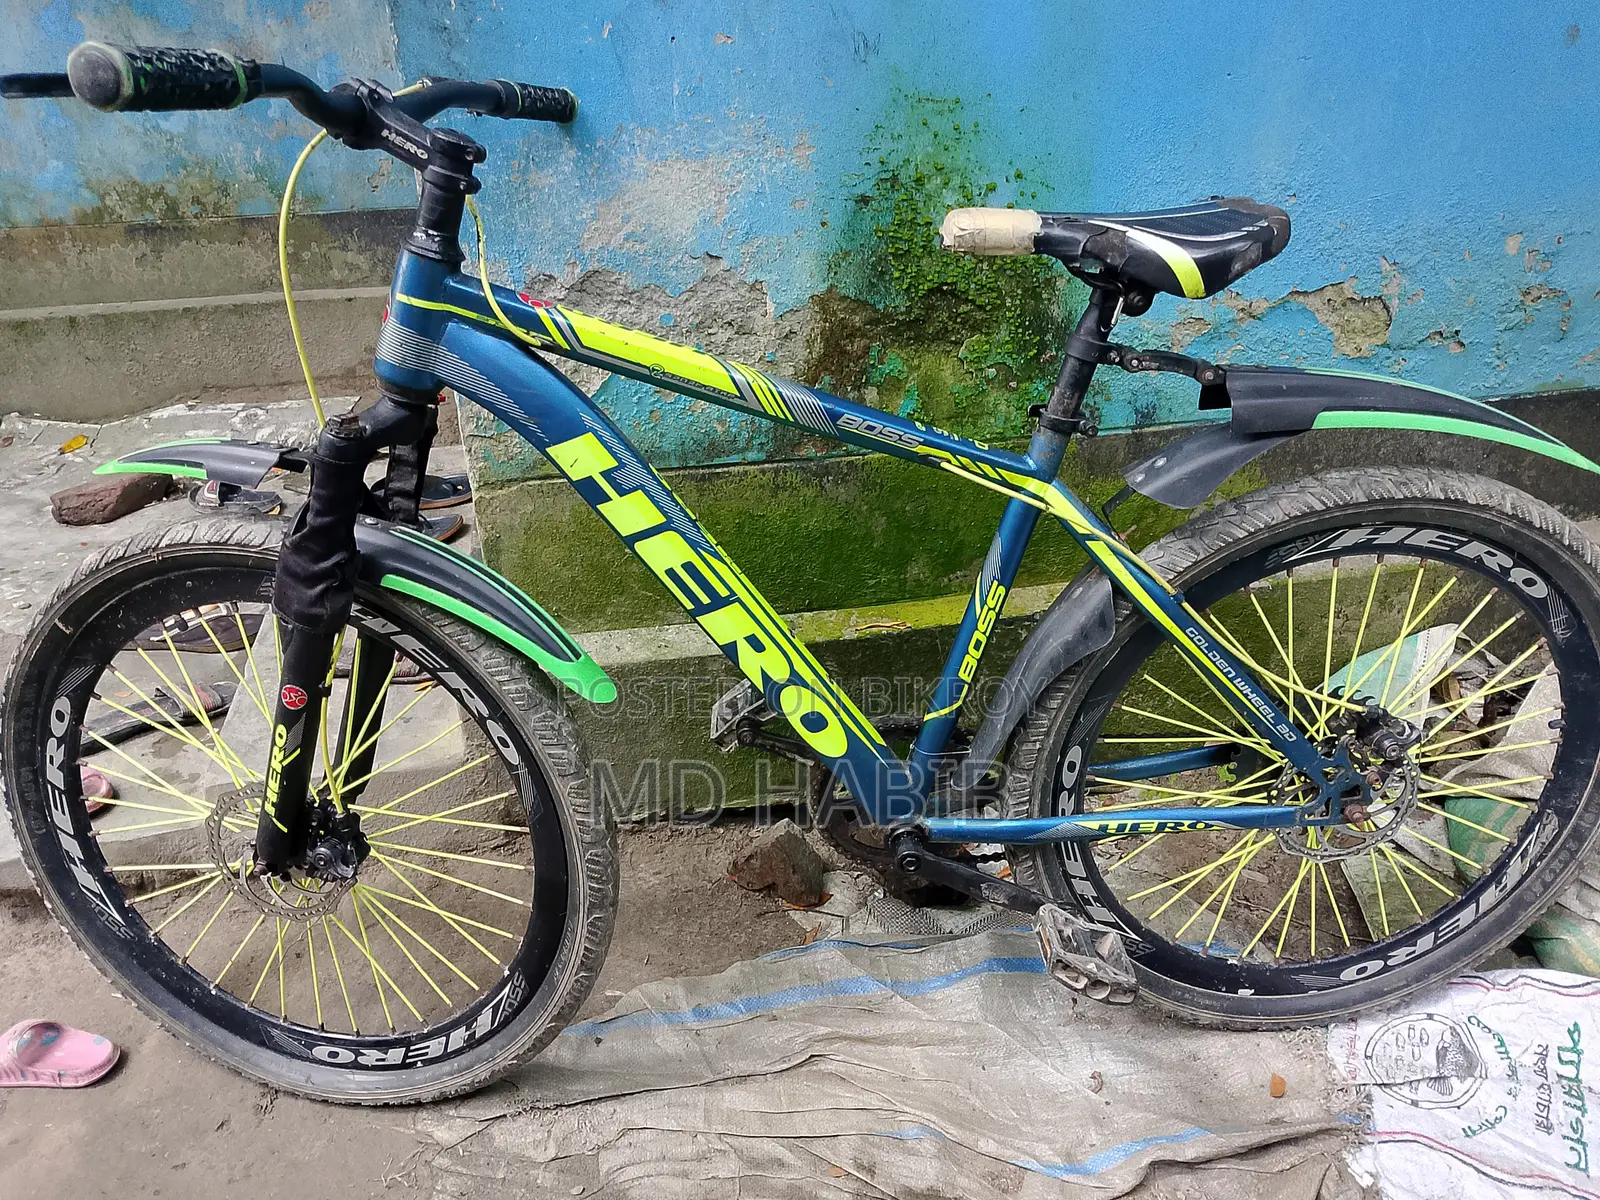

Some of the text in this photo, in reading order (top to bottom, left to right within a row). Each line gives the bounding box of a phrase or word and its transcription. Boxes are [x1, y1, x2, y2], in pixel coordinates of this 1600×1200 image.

[381, 129, 428, 159] HERO
[836, 413, 924, 448] BOSS
[545, 432, 848, 757] HERO
[1328, 527, 1548, 598] HERO
[958, 579, 1006, 683] BOSS
[1185, 627, 1297, 742] GOLDEN WHEEL BD
[46, 695, 100, 894] HERO
[264, 723, 287, 817] HERO
[1098, 820, 1214, 834] HERO
[1339, 855, 1523, 981] HERO
[311, 1008, 493, 1065] HERO
[1533, 1043, 1549, 1081] মৎস্য
[1461, 1105, 1508, 1138] পোনা
[1556, 1020, 1591, 1179] প্যারাগন
